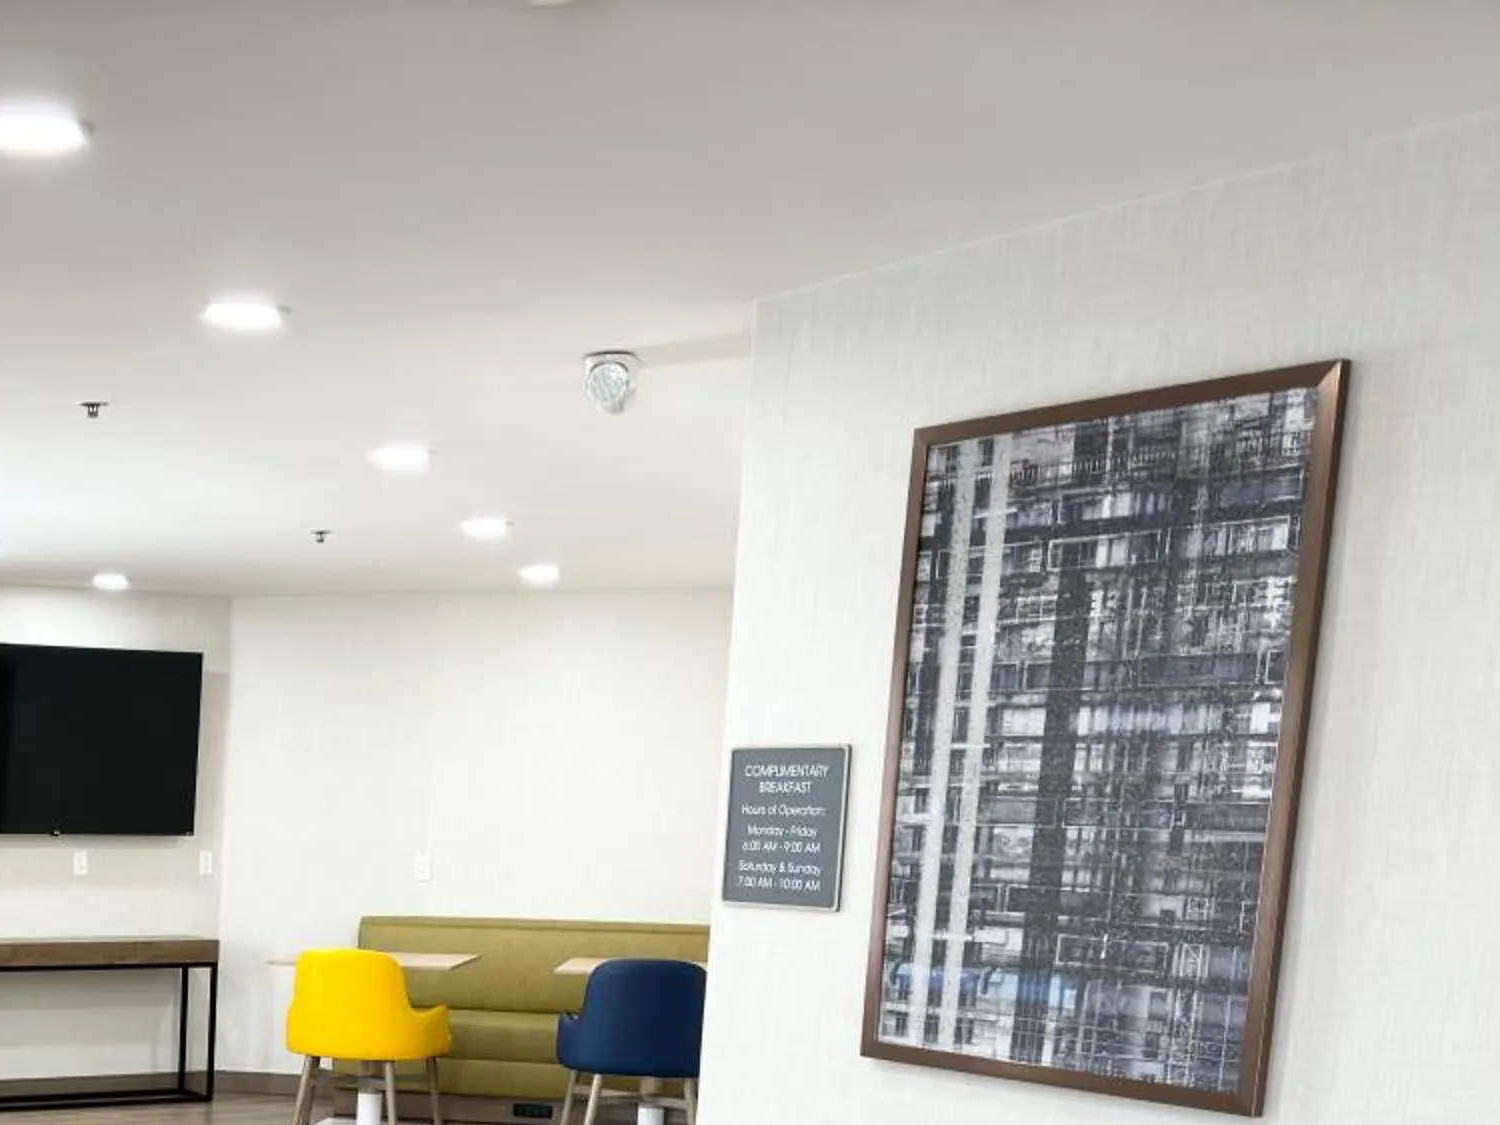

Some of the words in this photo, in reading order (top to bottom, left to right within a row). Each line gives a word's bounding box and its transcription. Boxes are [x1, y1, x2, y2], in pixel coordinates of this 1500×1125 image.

[745, 764, 829, 777] COMPLIMENTARY
[759, 781, 812, 793] BREAKFAST
[741, 803, 766, 815] Hours
[767, 804, 778, 815] of
[747, 824, 784, 837] Monday
[790, 825, 818, 838] Friday
[763, 841, 778, 852] AM
[804, 842, 821, 853] AM
[739, 860, 777, 874] Saturday
[787, 862, 821, 876] Sunday
[757, 876, 773, 889] AM
[804, 879, 821, 892] AM
